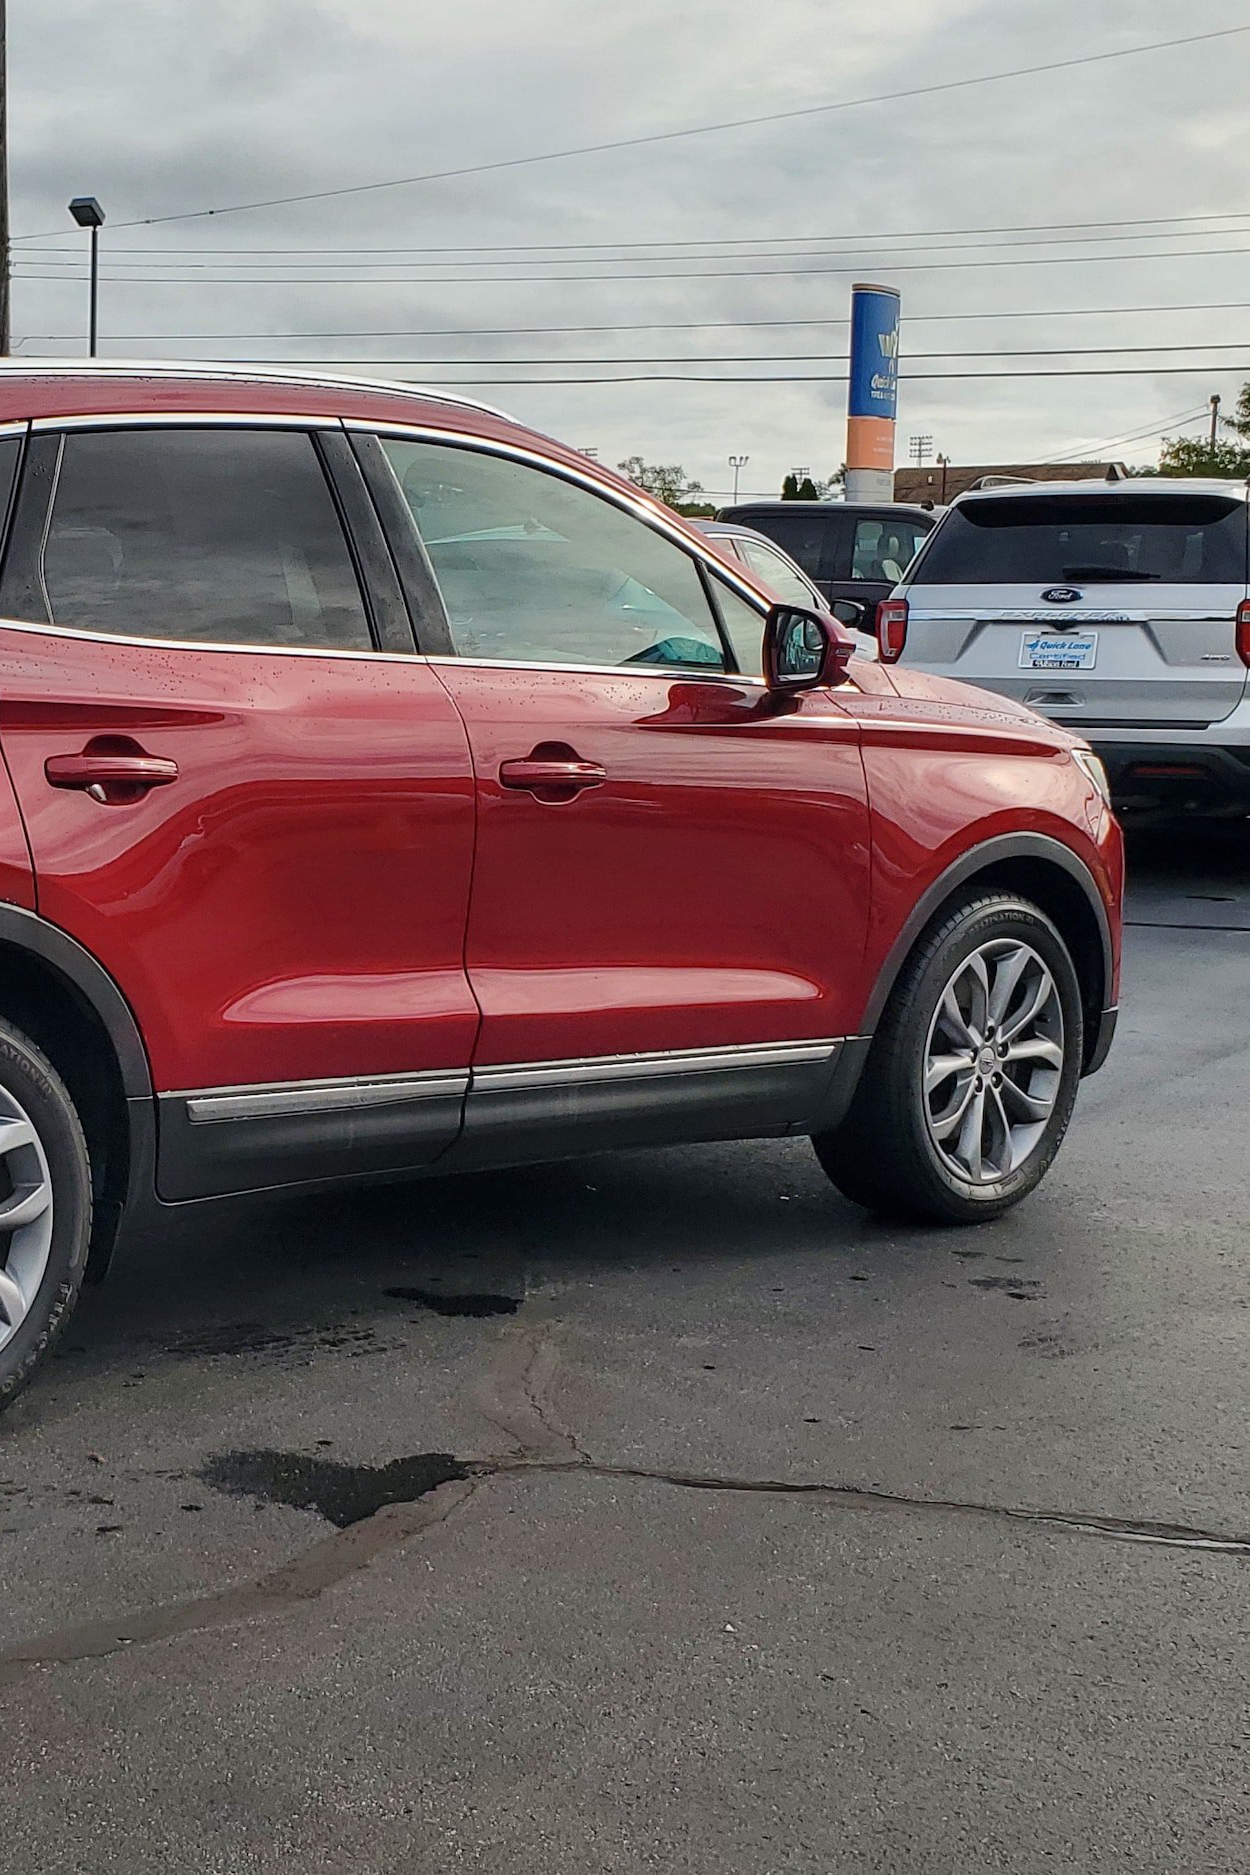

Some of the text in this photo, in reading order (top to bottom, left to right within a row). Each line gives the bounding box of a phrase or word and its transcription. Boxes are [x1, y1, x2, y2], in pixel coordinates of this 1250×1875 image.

[1047, 590, 1073, 599] Ford
[1040, 641, 1092, 650] Quick Lane
[1029, 652, 1086, 661] Certified
